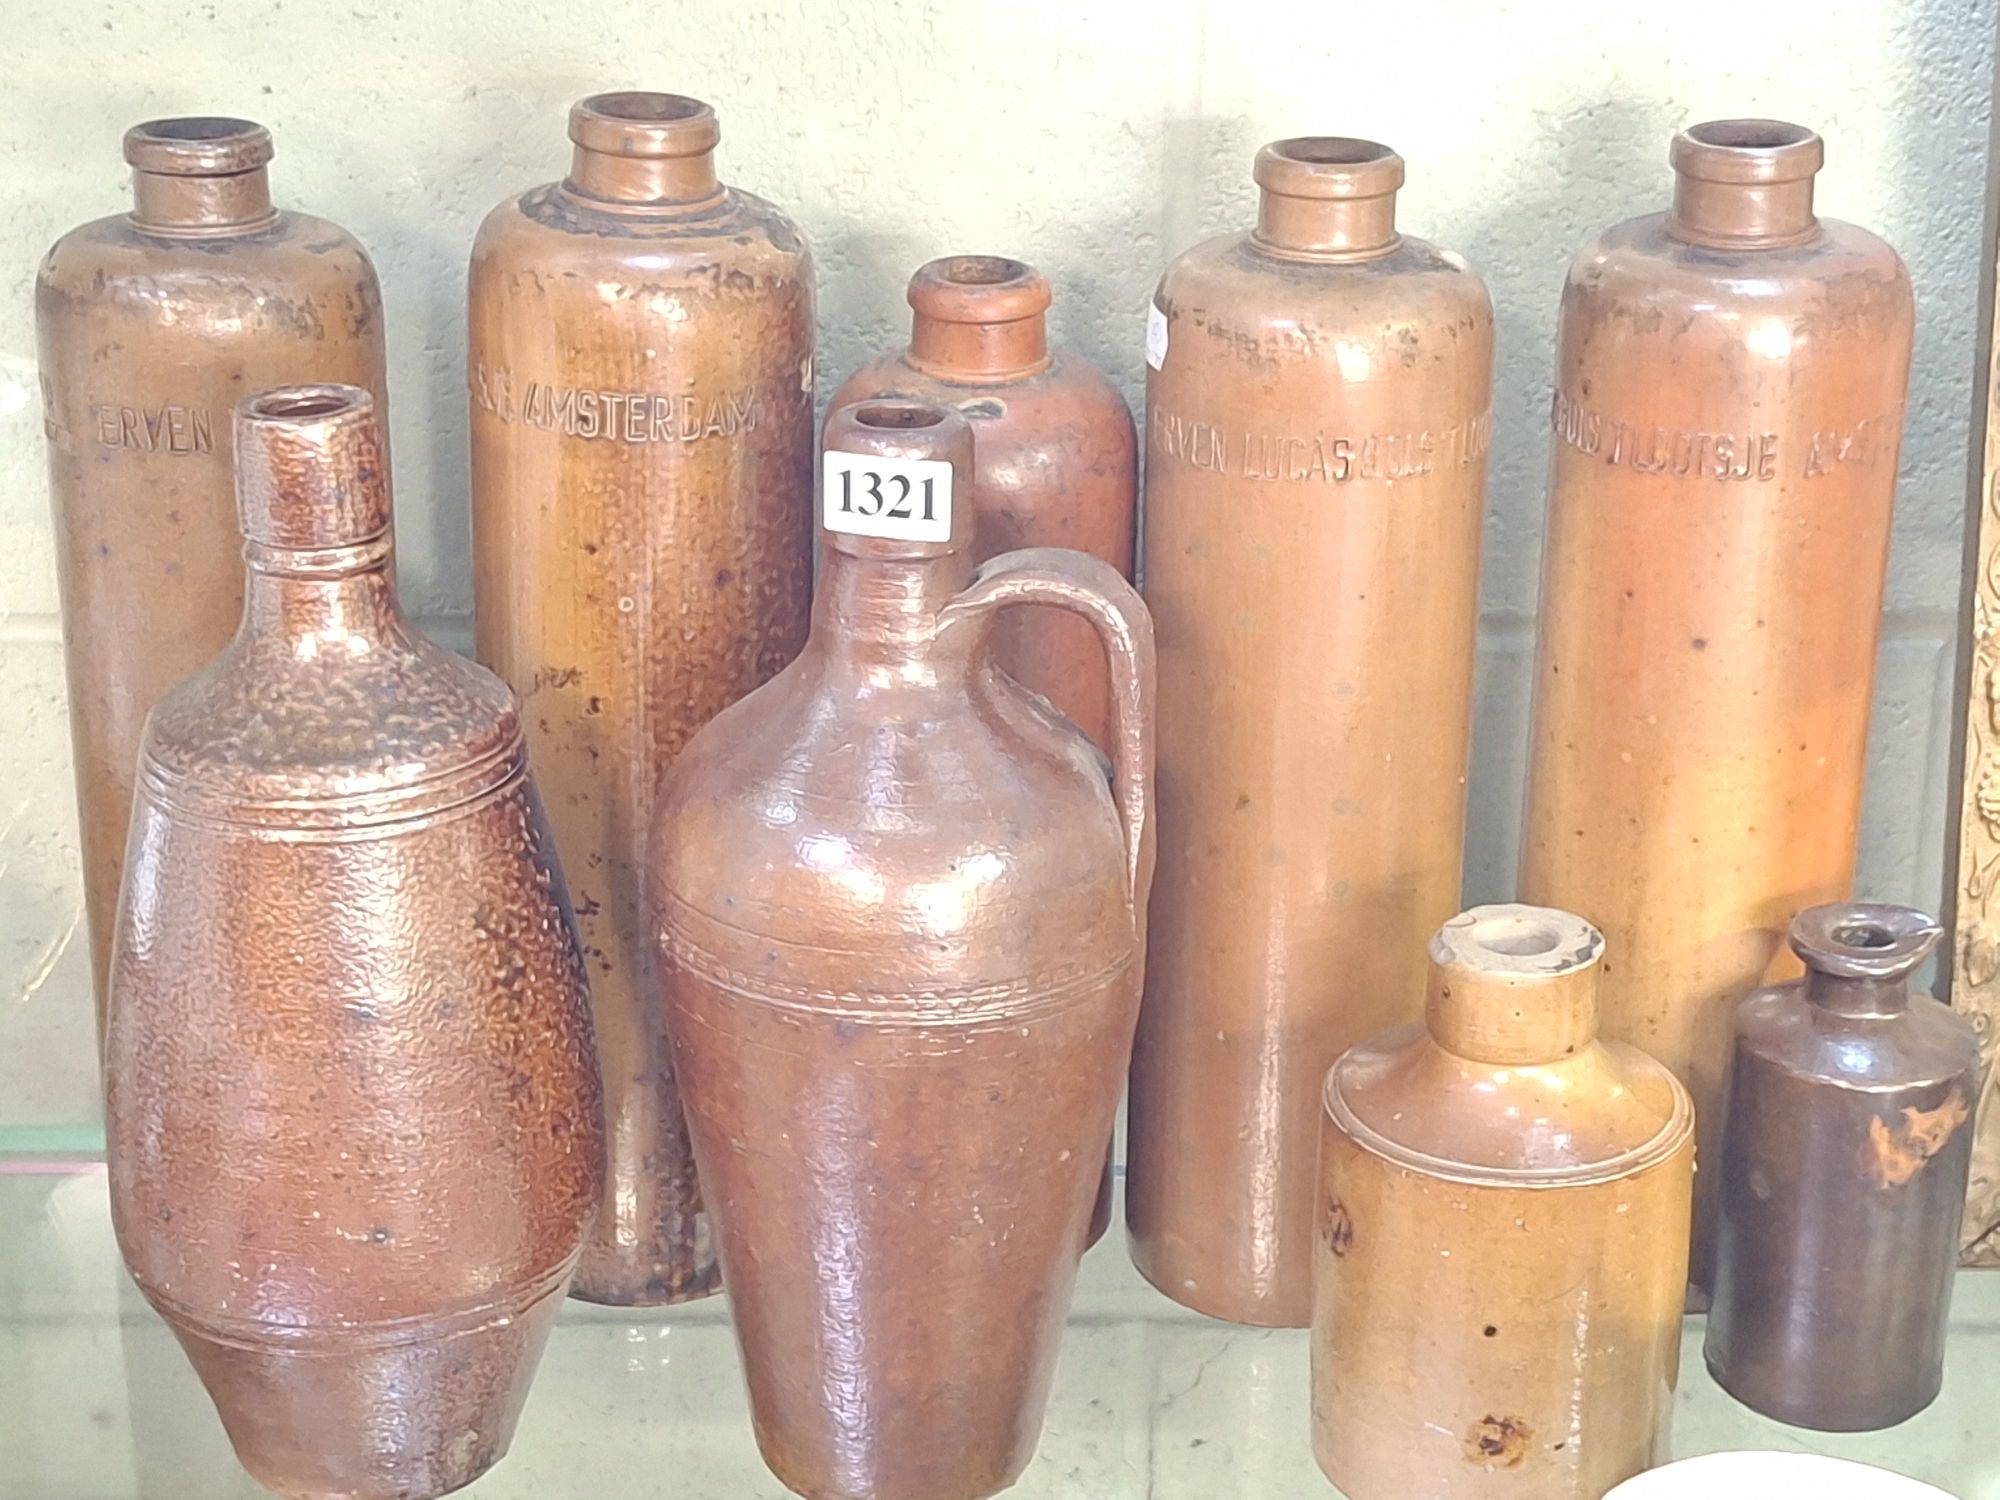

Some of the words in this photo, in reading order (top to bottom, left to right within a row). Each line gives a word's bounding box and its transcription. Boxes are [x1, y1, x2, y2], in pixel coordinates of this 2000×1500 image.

[98, 402, 216, 456] ERVEN
[523, 382, 756, 443] AMSTERDAM
[1243, 432, 1352, 482] LUCAS
[837, 469, 939, 522] 1321
